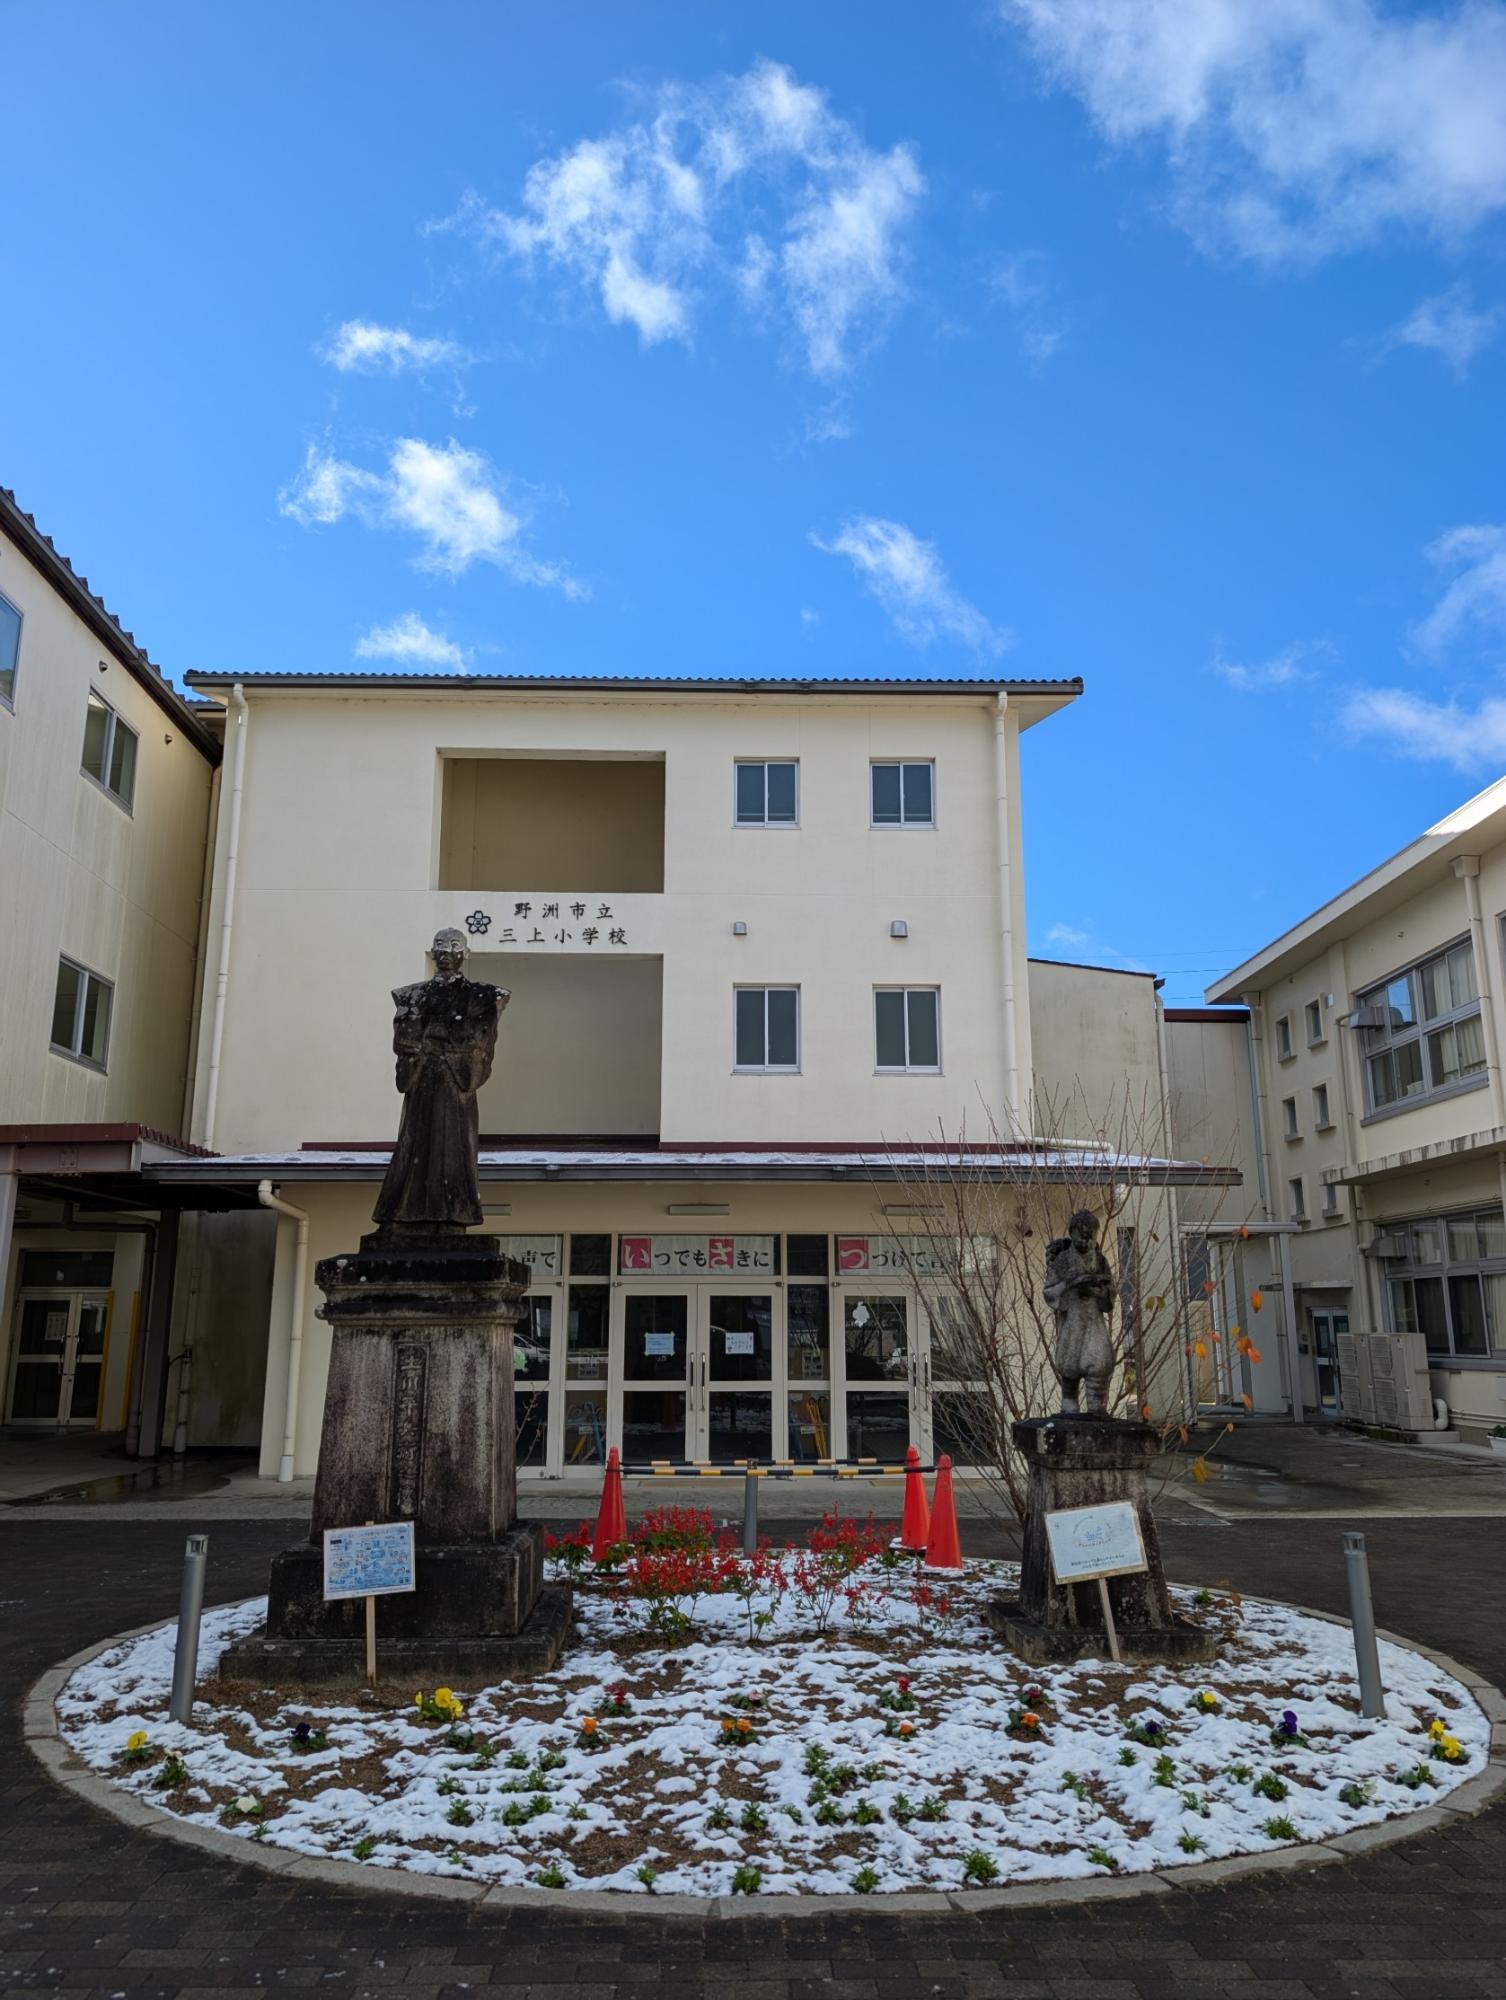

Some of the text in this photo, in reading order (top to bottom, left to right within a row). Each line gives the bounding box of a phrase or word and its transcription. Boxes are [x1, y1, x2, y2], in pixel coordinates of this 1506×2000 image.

[514, 901, 613, 920] 野洲市立
[499, 926, 628, 945] 三上小学校
[623, 1242, 770, 1269] いつでもさきに
